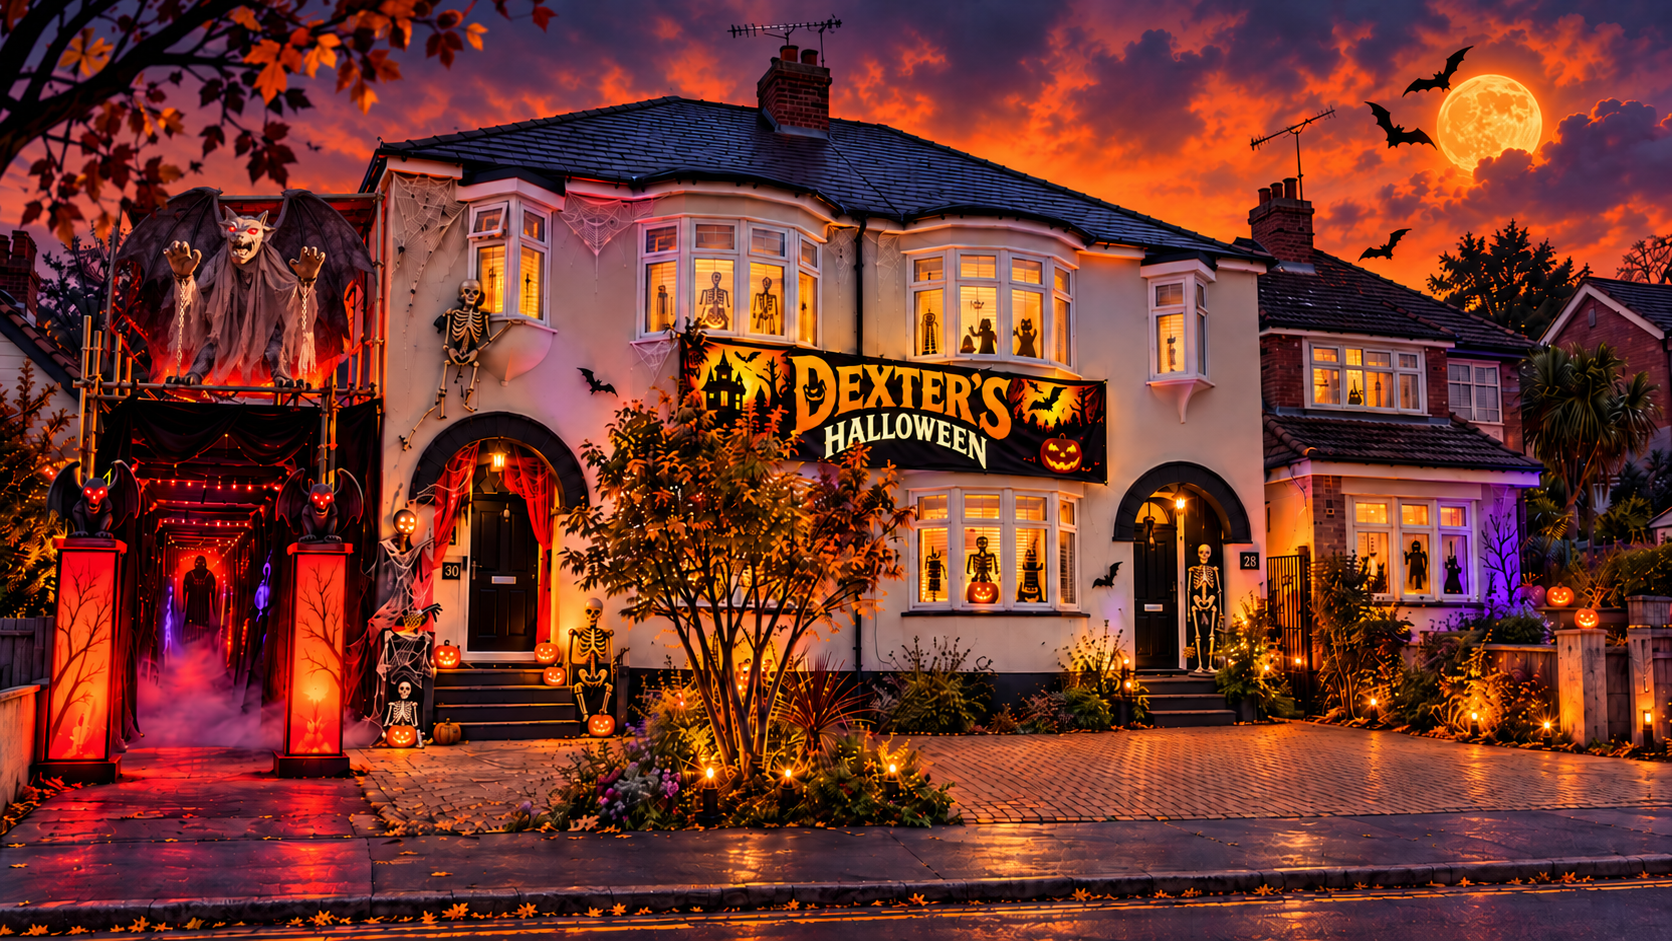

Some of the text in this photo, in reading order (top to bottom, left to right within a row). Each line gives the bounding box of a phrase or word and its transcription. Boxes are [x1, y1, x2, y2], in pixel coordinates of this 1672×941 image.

[788, 355, 1012, 440] DEXTER'S
[824, 413, 987, 470] HALLOWEEN
[445, 565, 459, 577] 30
[1244, 555, 1256, 567] 28
